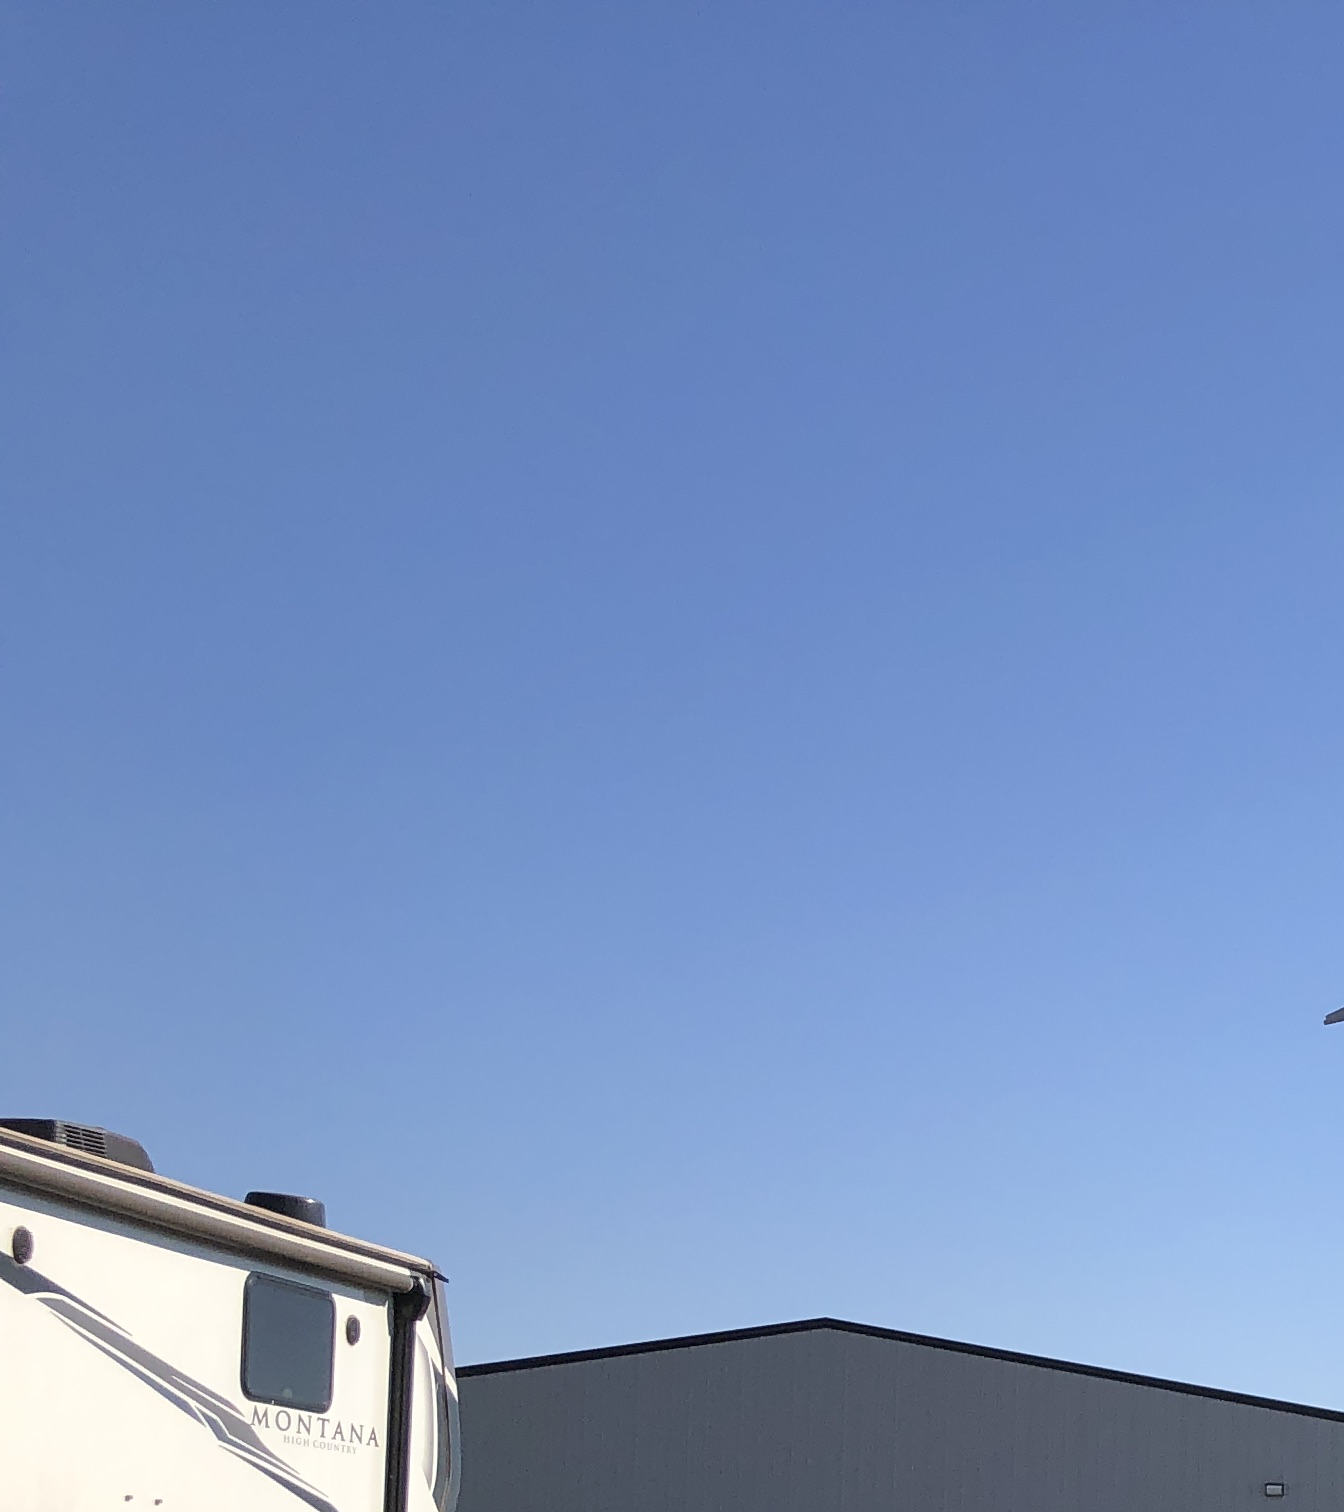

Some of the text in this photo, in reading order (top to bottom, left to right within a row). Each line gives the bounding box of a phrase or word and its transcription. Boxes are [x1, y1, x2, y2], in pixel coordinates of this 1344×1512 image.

[250, 1405, 380, 1448] MONTANA
[283, 1435, 358, 1455] HIGH COUNTRY
